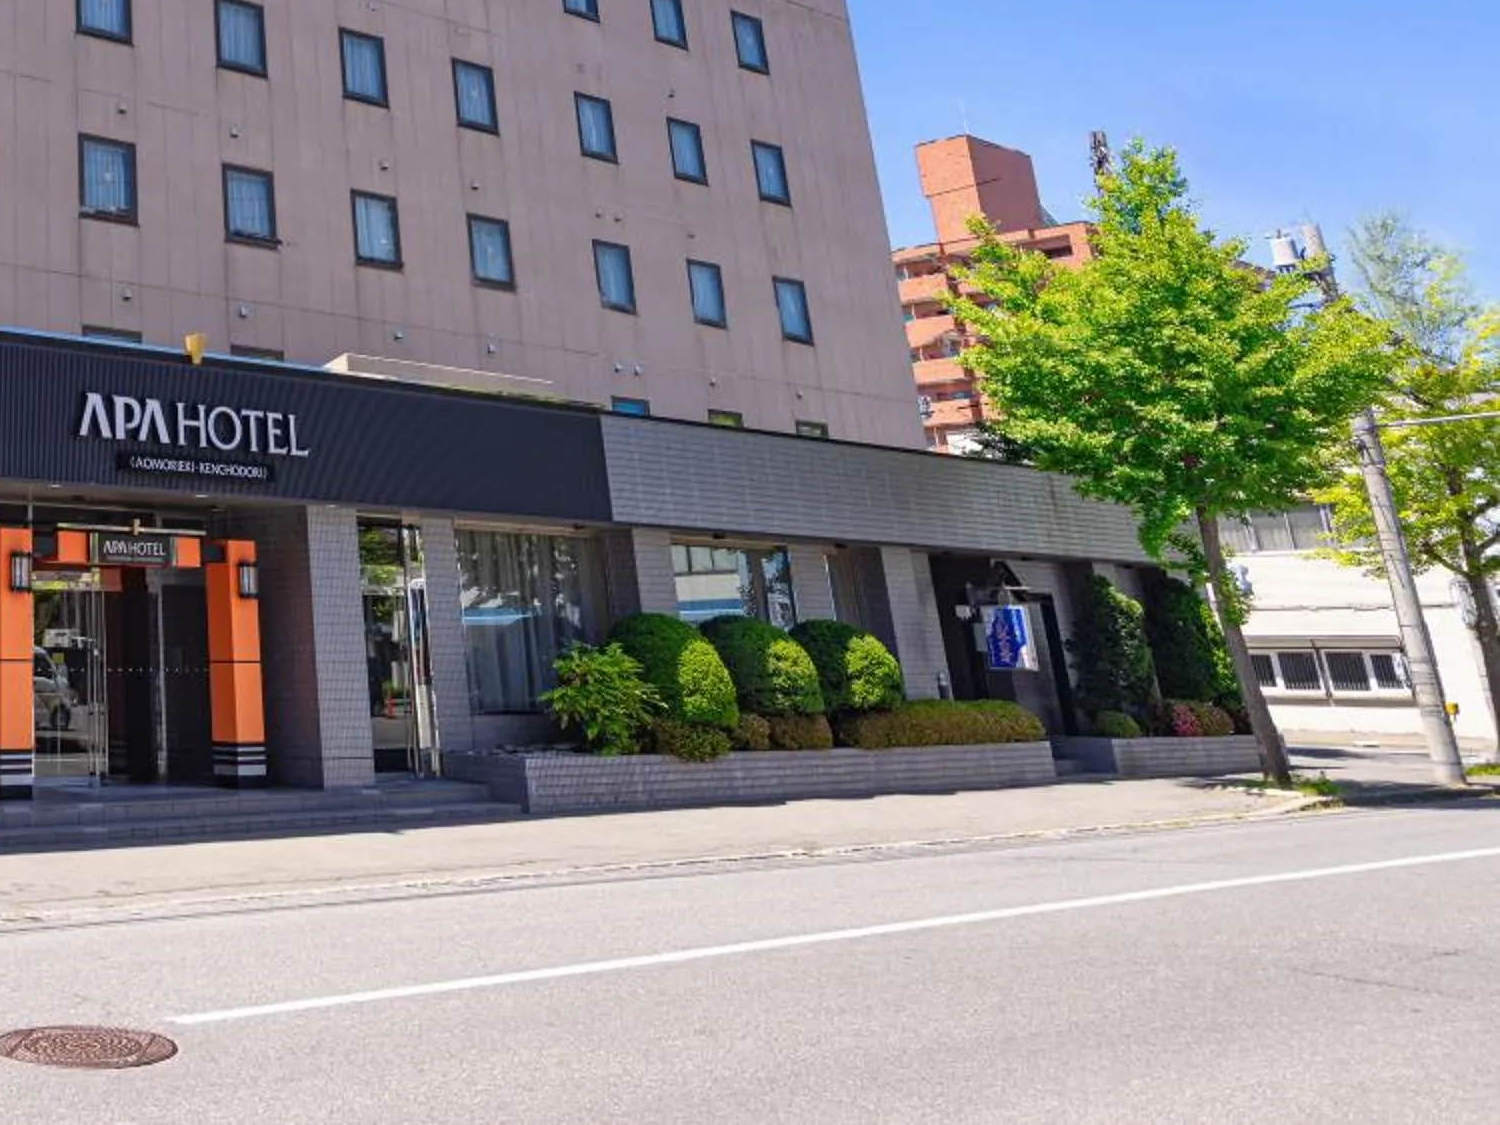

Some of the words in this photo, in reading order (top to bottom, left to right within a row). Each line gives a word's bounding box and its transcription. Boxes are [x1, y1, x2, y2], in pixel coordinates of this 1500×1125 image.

[79, 392, 171, 444] APA
[176, 402, 311, 457] HOTEL
[103, 539, 127, 554] APA
[129, 542, 166, 555] HOTEL
